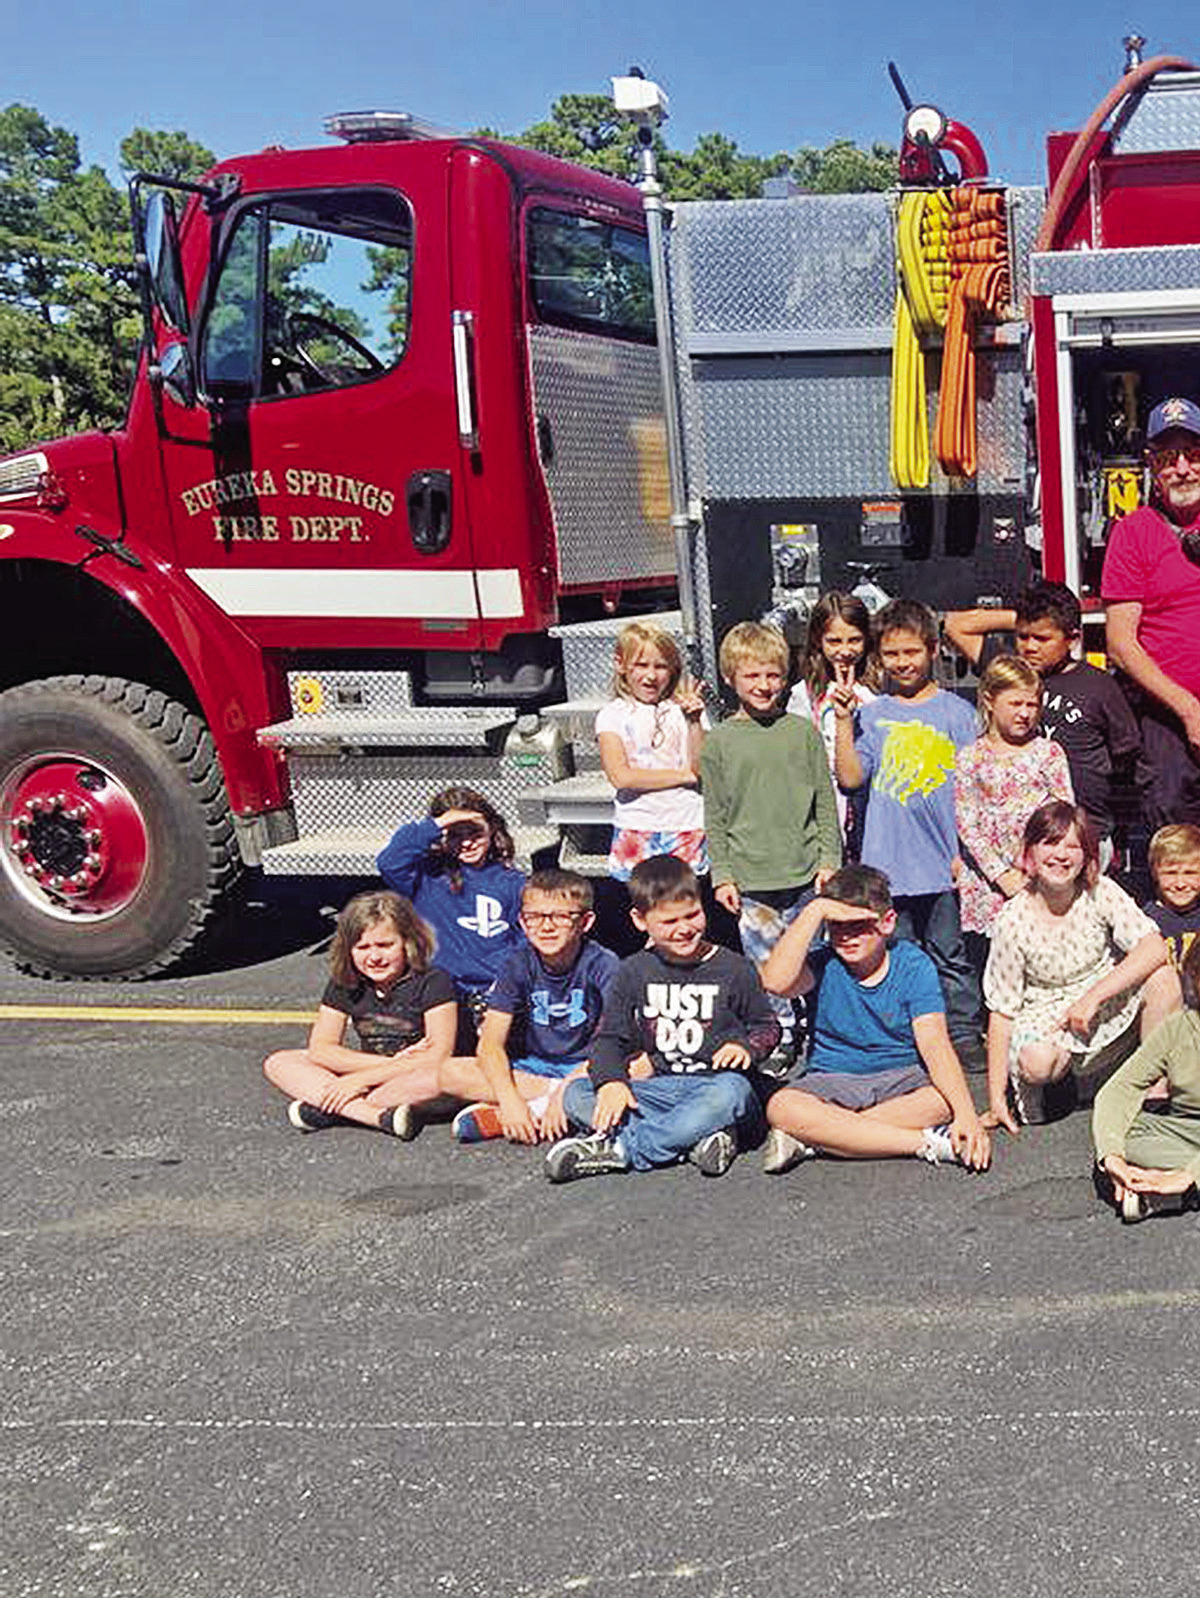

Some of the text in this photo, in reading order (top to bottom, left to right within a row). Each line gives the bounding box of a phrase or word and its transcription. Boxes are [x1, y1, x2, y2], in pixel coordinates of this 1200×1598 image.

[181, 468, 395, 516] EUREKA SPRINGS
[212, 516, 370, 542] FIRE DEPT.
[642, 983, 720, 1020] JUST
[655, 1016, 705, 1055] DO
